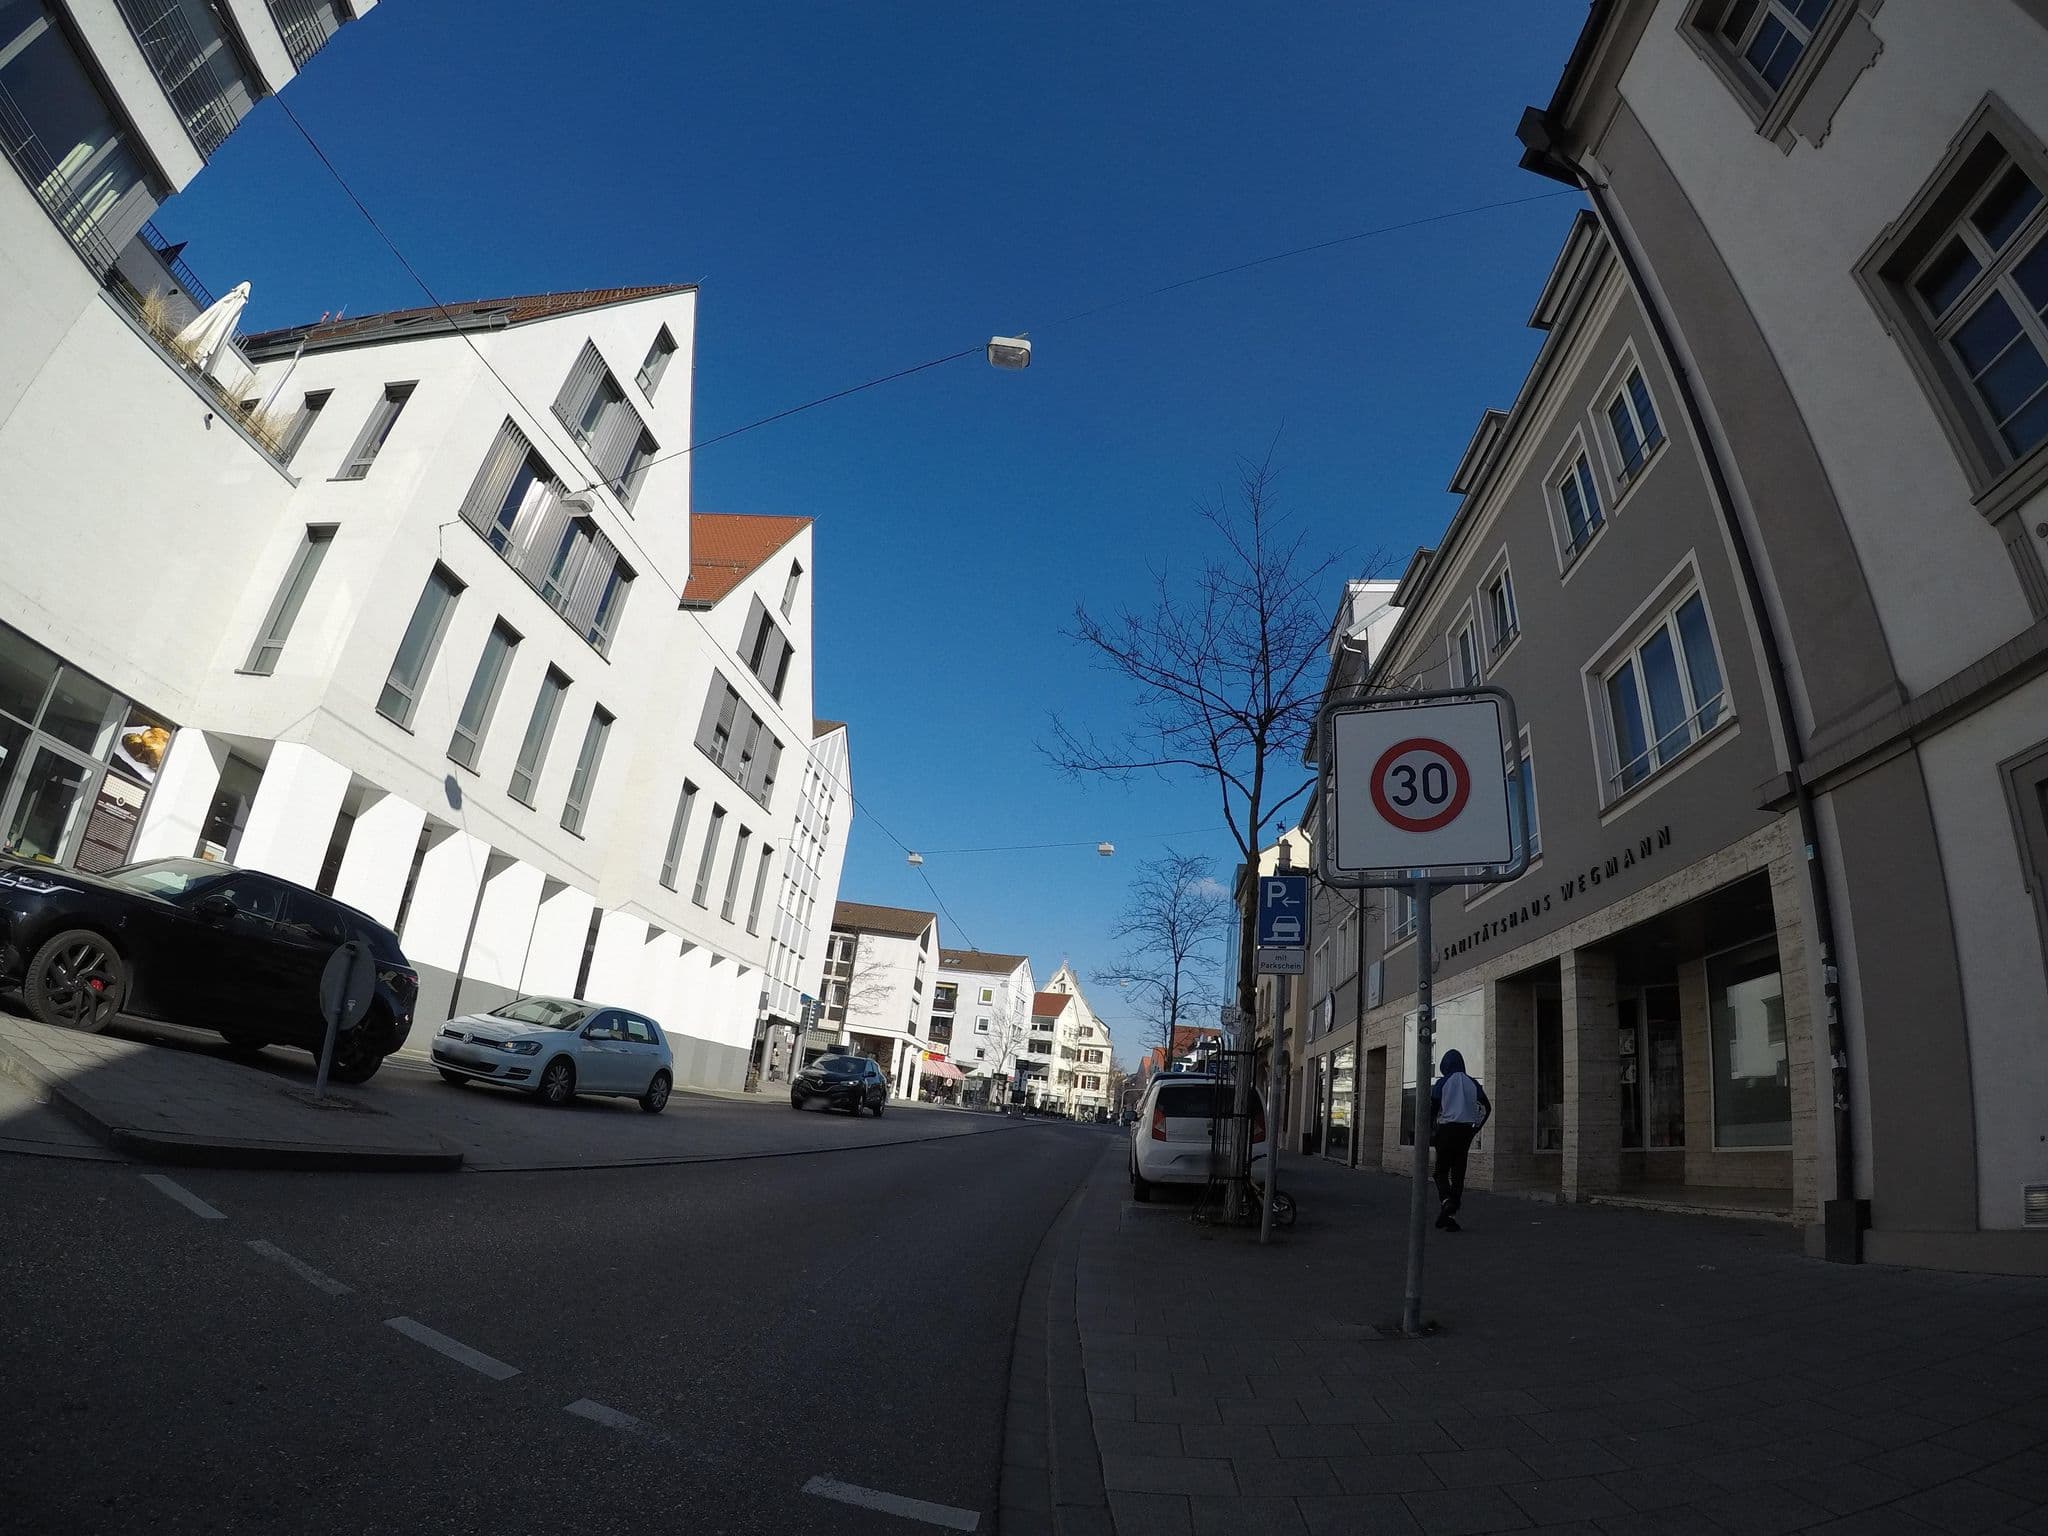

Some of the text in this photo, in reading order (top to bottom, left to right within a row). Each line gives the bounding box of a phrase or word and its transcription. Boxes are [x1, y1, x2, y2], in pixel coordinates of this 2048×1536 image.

[1391, 762, 1449, 806] 30
[1267, 881, 1287, 908] P
[1444, 825, 1672, 960] SANITÄTSHAUS WEGMANN
[1260, 962, 1302, 971] Parkschein
